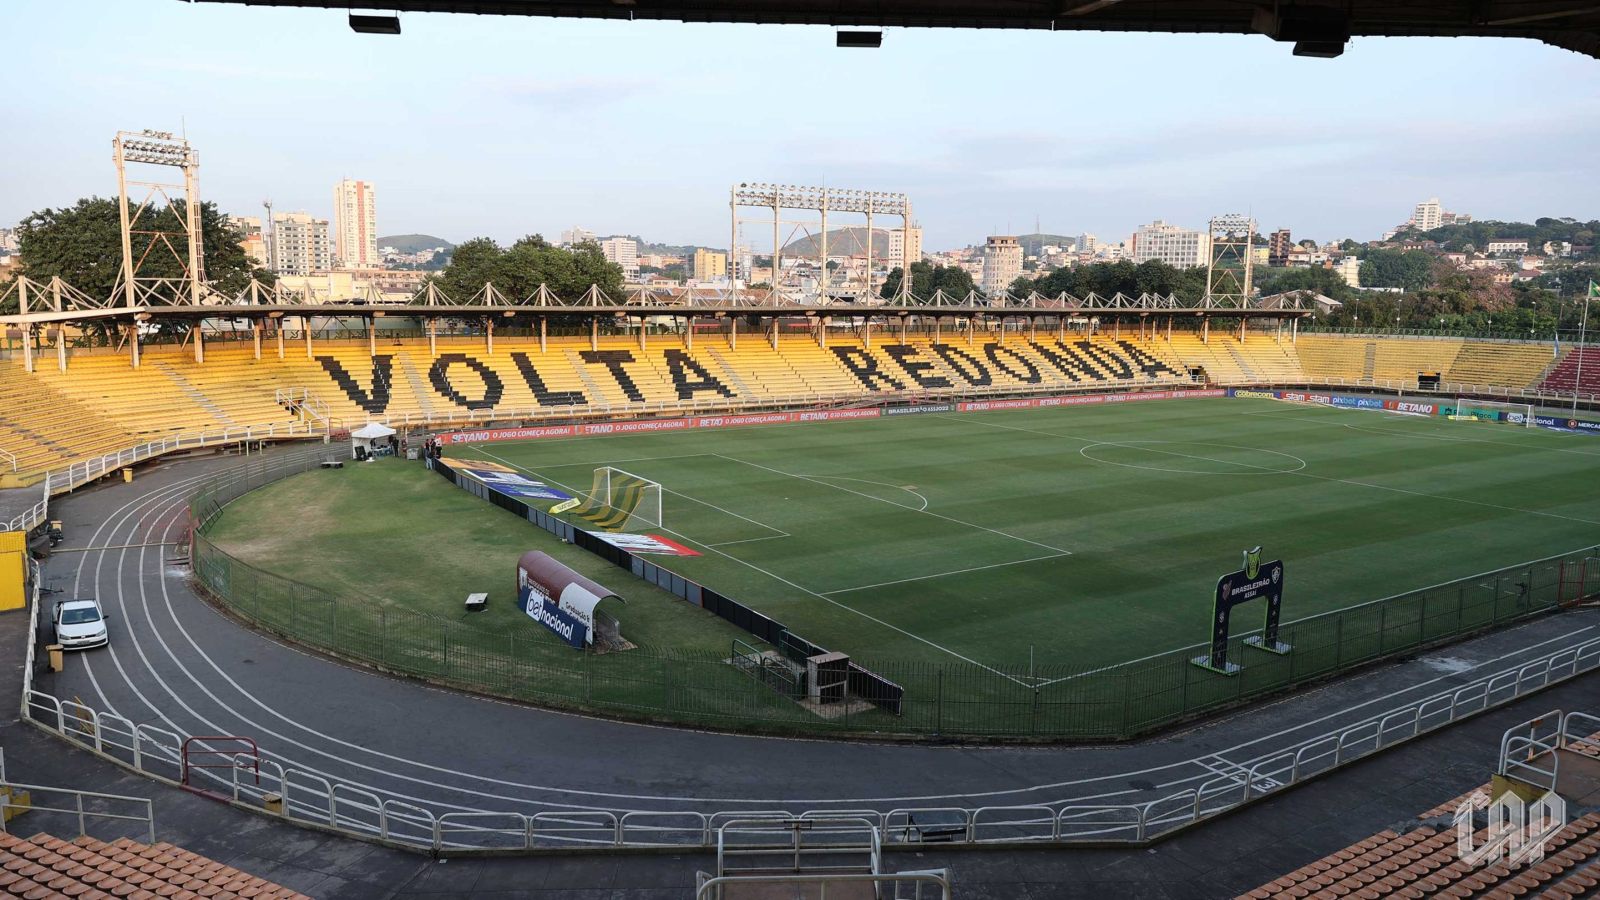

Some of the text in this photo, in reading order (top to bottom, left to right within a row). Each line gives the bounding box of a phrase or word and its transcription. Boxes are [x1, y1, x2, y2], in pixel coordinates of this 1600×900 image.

[314, 341, 1182, 414] VOLTA REDONDA
[1284, 392, 1330, 404] stam stam
[966, 402, 989, 411] BETANO
[1397, 402, 1432, 414] BETANO
[800, 412, 828, 420] BETANO
[518, 430, 544, 438] COMEÇA
[1232, 578, 1270, 596] BRASILEIRÃO
